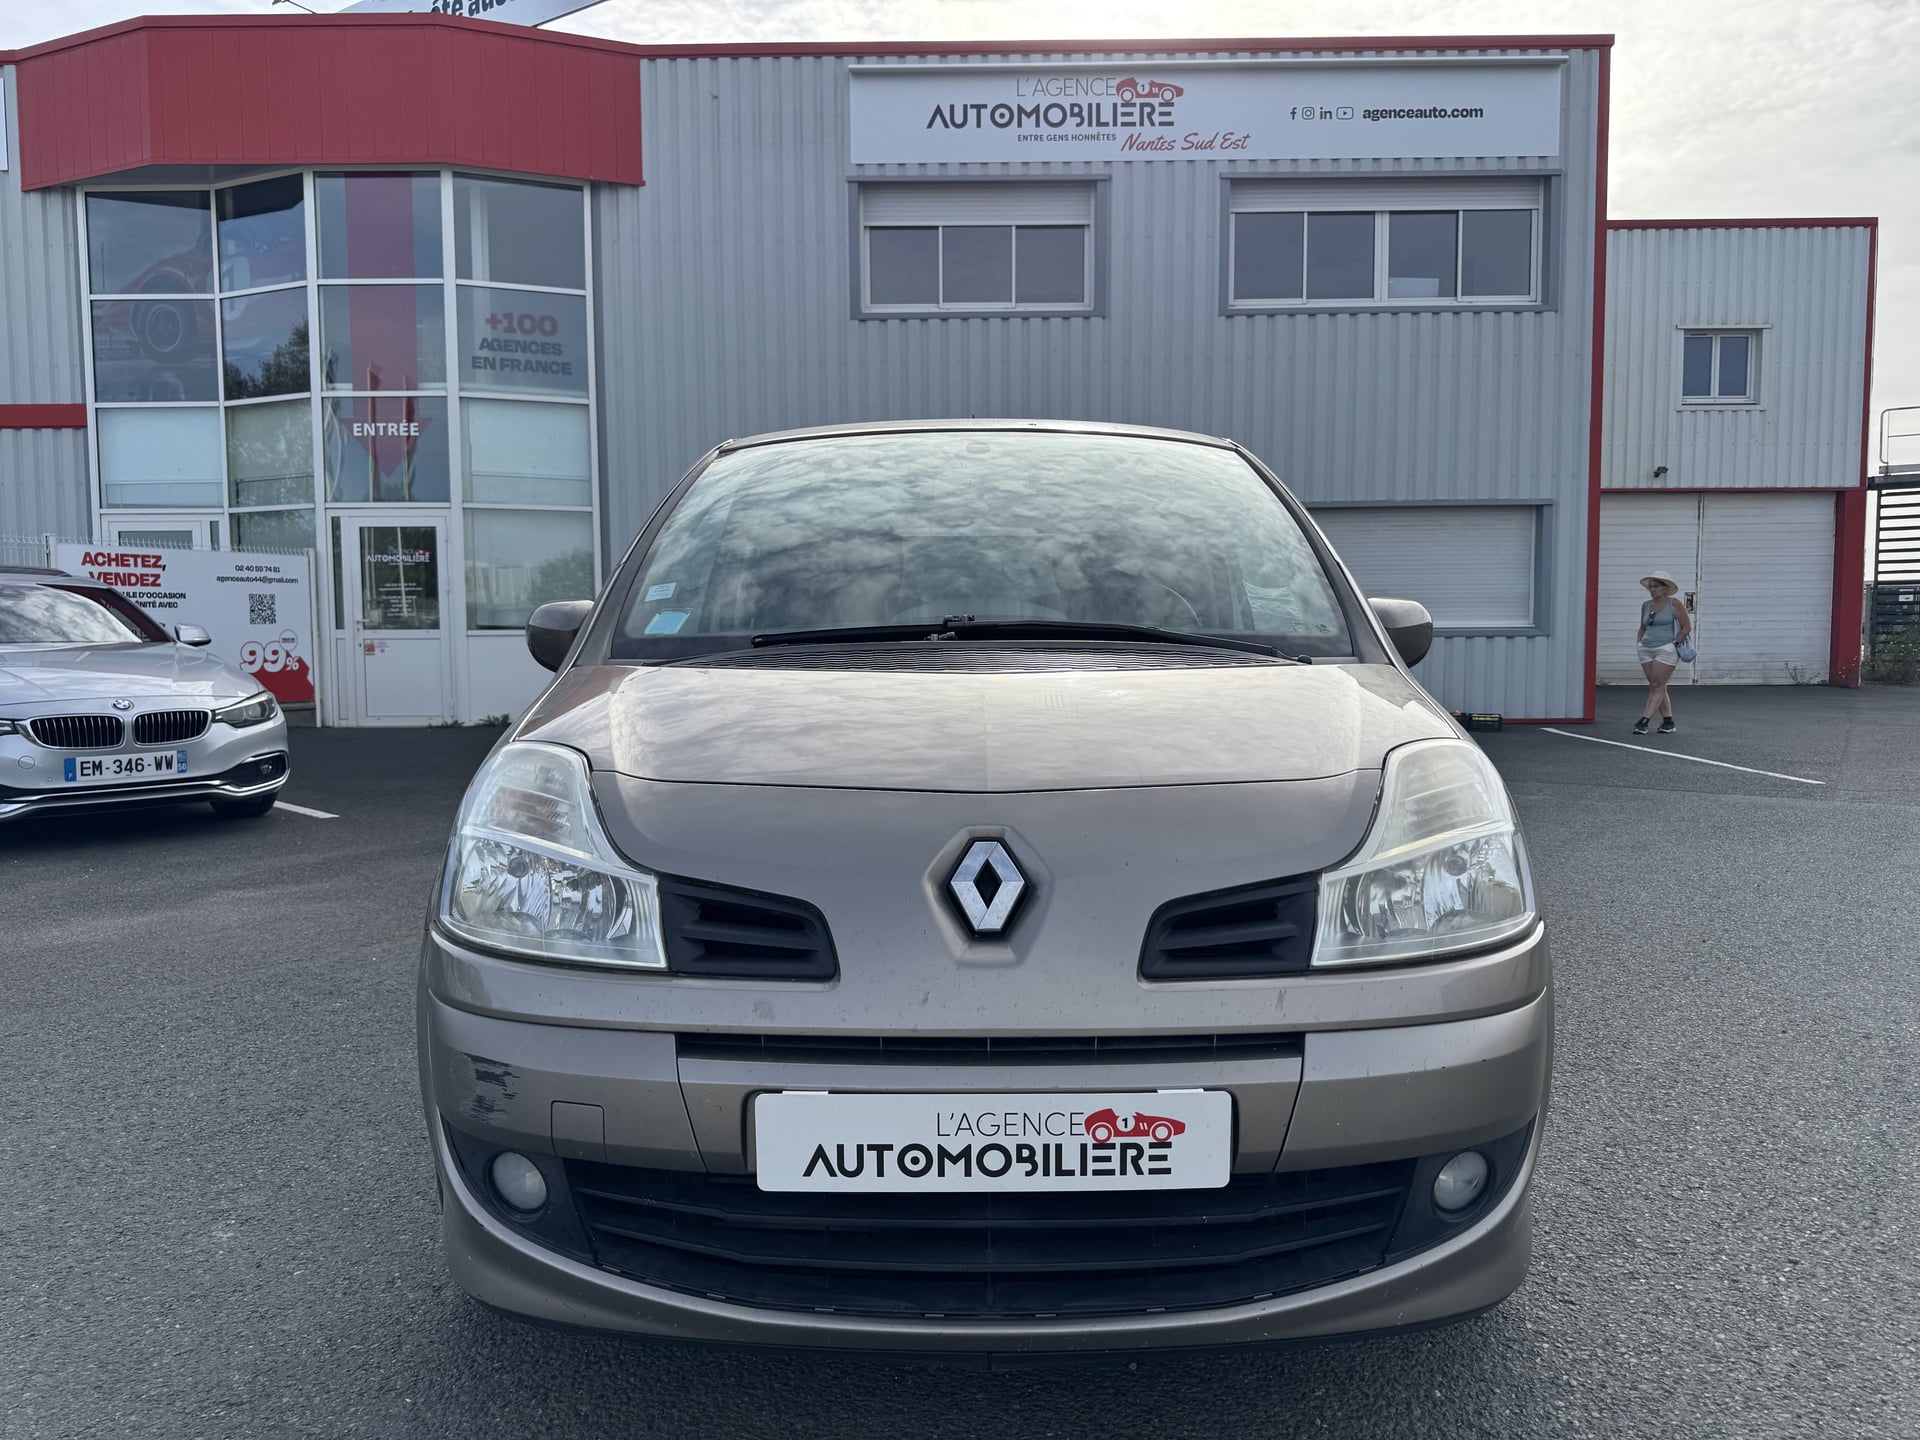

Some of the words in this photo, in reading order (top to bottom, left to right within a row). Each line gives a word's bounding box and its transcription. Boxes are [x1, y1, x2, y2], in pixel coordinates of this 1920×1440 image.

[1016, 77, 1117, 98] L'AGENCE
[1362, 107, 1484, 121] agenceauto.com
[1017, 134, 1045, 143] ENTRE
[1046, 134, 1069, 142] GENS
[1071, 132, 1117, 142] HONNÊTES
[1120, 132, 1176, 152] Nantes
[1181, 131, 1220, 150] Sud
[1219, 131, 1252, 150] Est
[485, 312, 560, 337] +100
[478, 337, 564, 356] AGENCES
[471, 355, 497, 371] EN
[499, 357, 573, 376] FRANCE
[353, 419, 420, 437] ENTRÉE
[81, 551, 167, 572] ACHETEZ,
[216, 575, 299, 585] agenceauto44@gmail.com
[138, 591, 187, 600] D'OCCASION
[157, 601, 179, 609] AVEC
[937, 1112, 1085, 1137] L'AGENCE
[1122, 1117, 1129, 1129] 1
